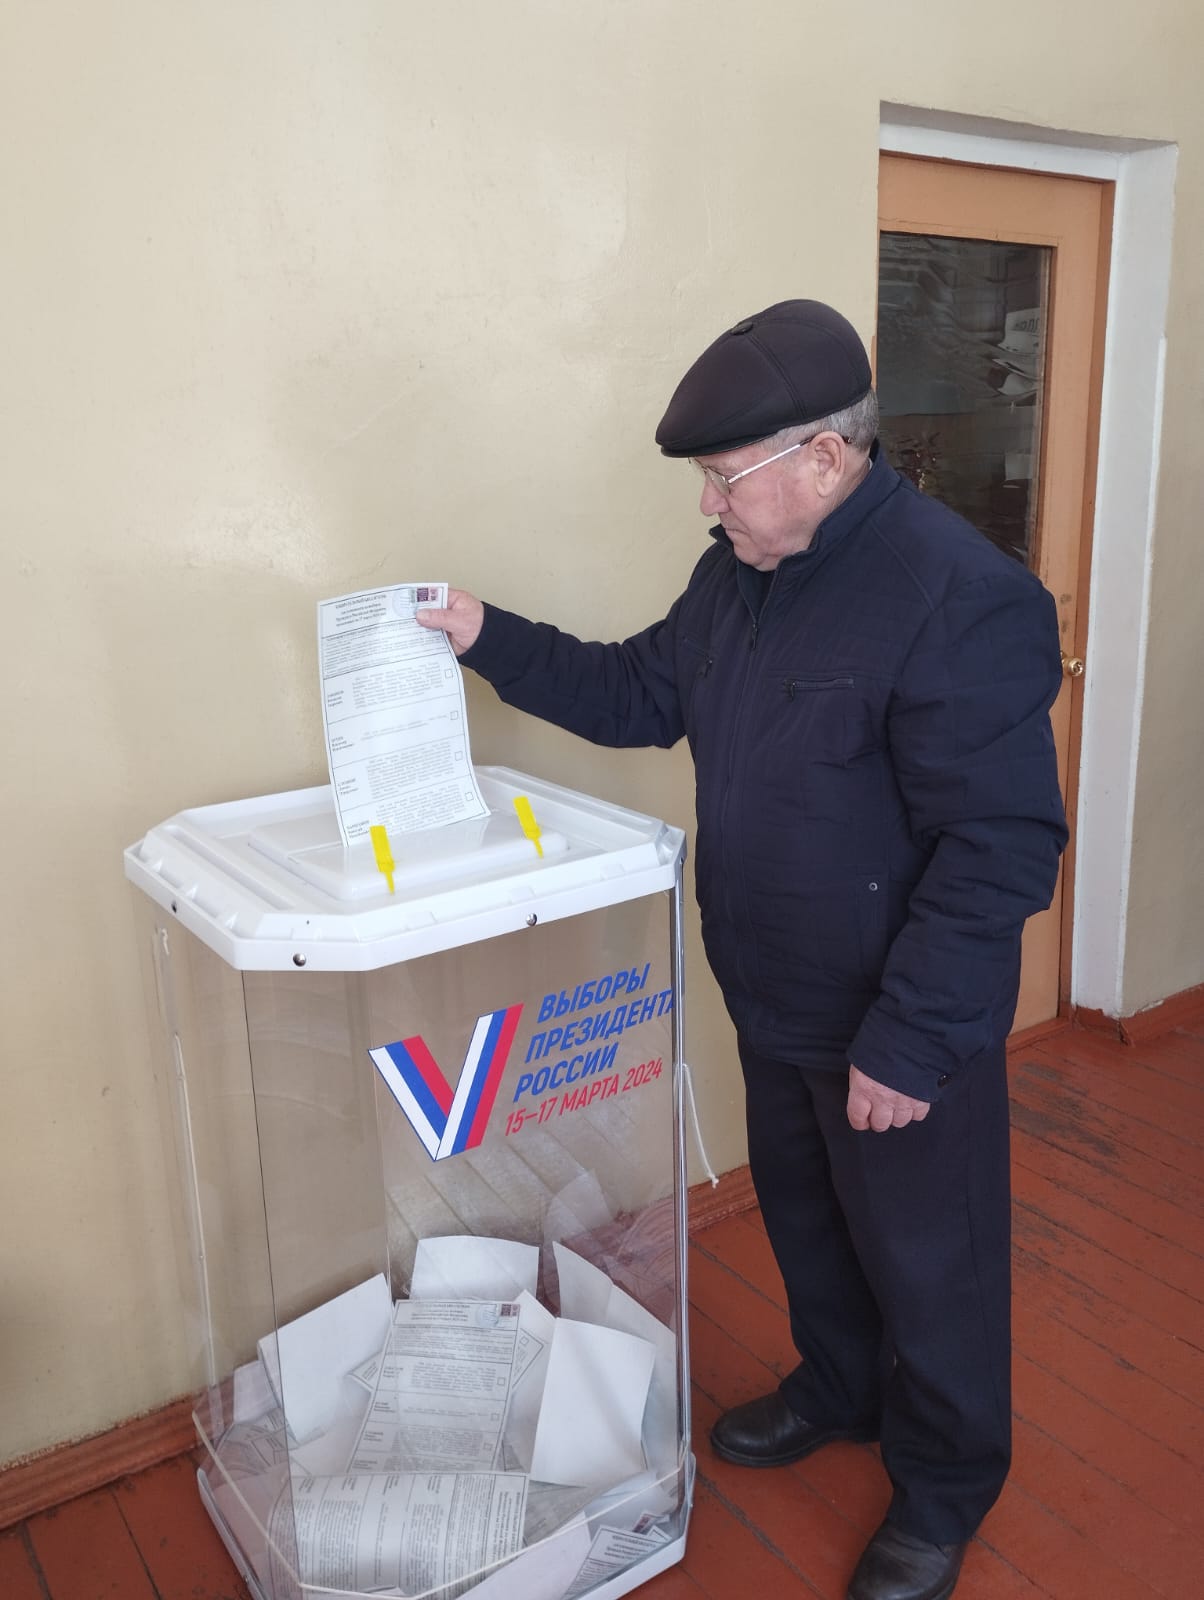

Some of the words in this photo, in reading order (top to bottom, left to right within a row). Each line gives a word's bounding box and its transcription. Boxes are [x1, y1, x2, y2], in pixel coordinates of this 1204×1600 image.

[537, 963, 651, 1024] ВЫБОРЫ
[513, 1042, 619, 1103] РОССИИ
[559, 1074, 619, 1116] МАРТА
[622, 1057, 662, 1092] 2024
